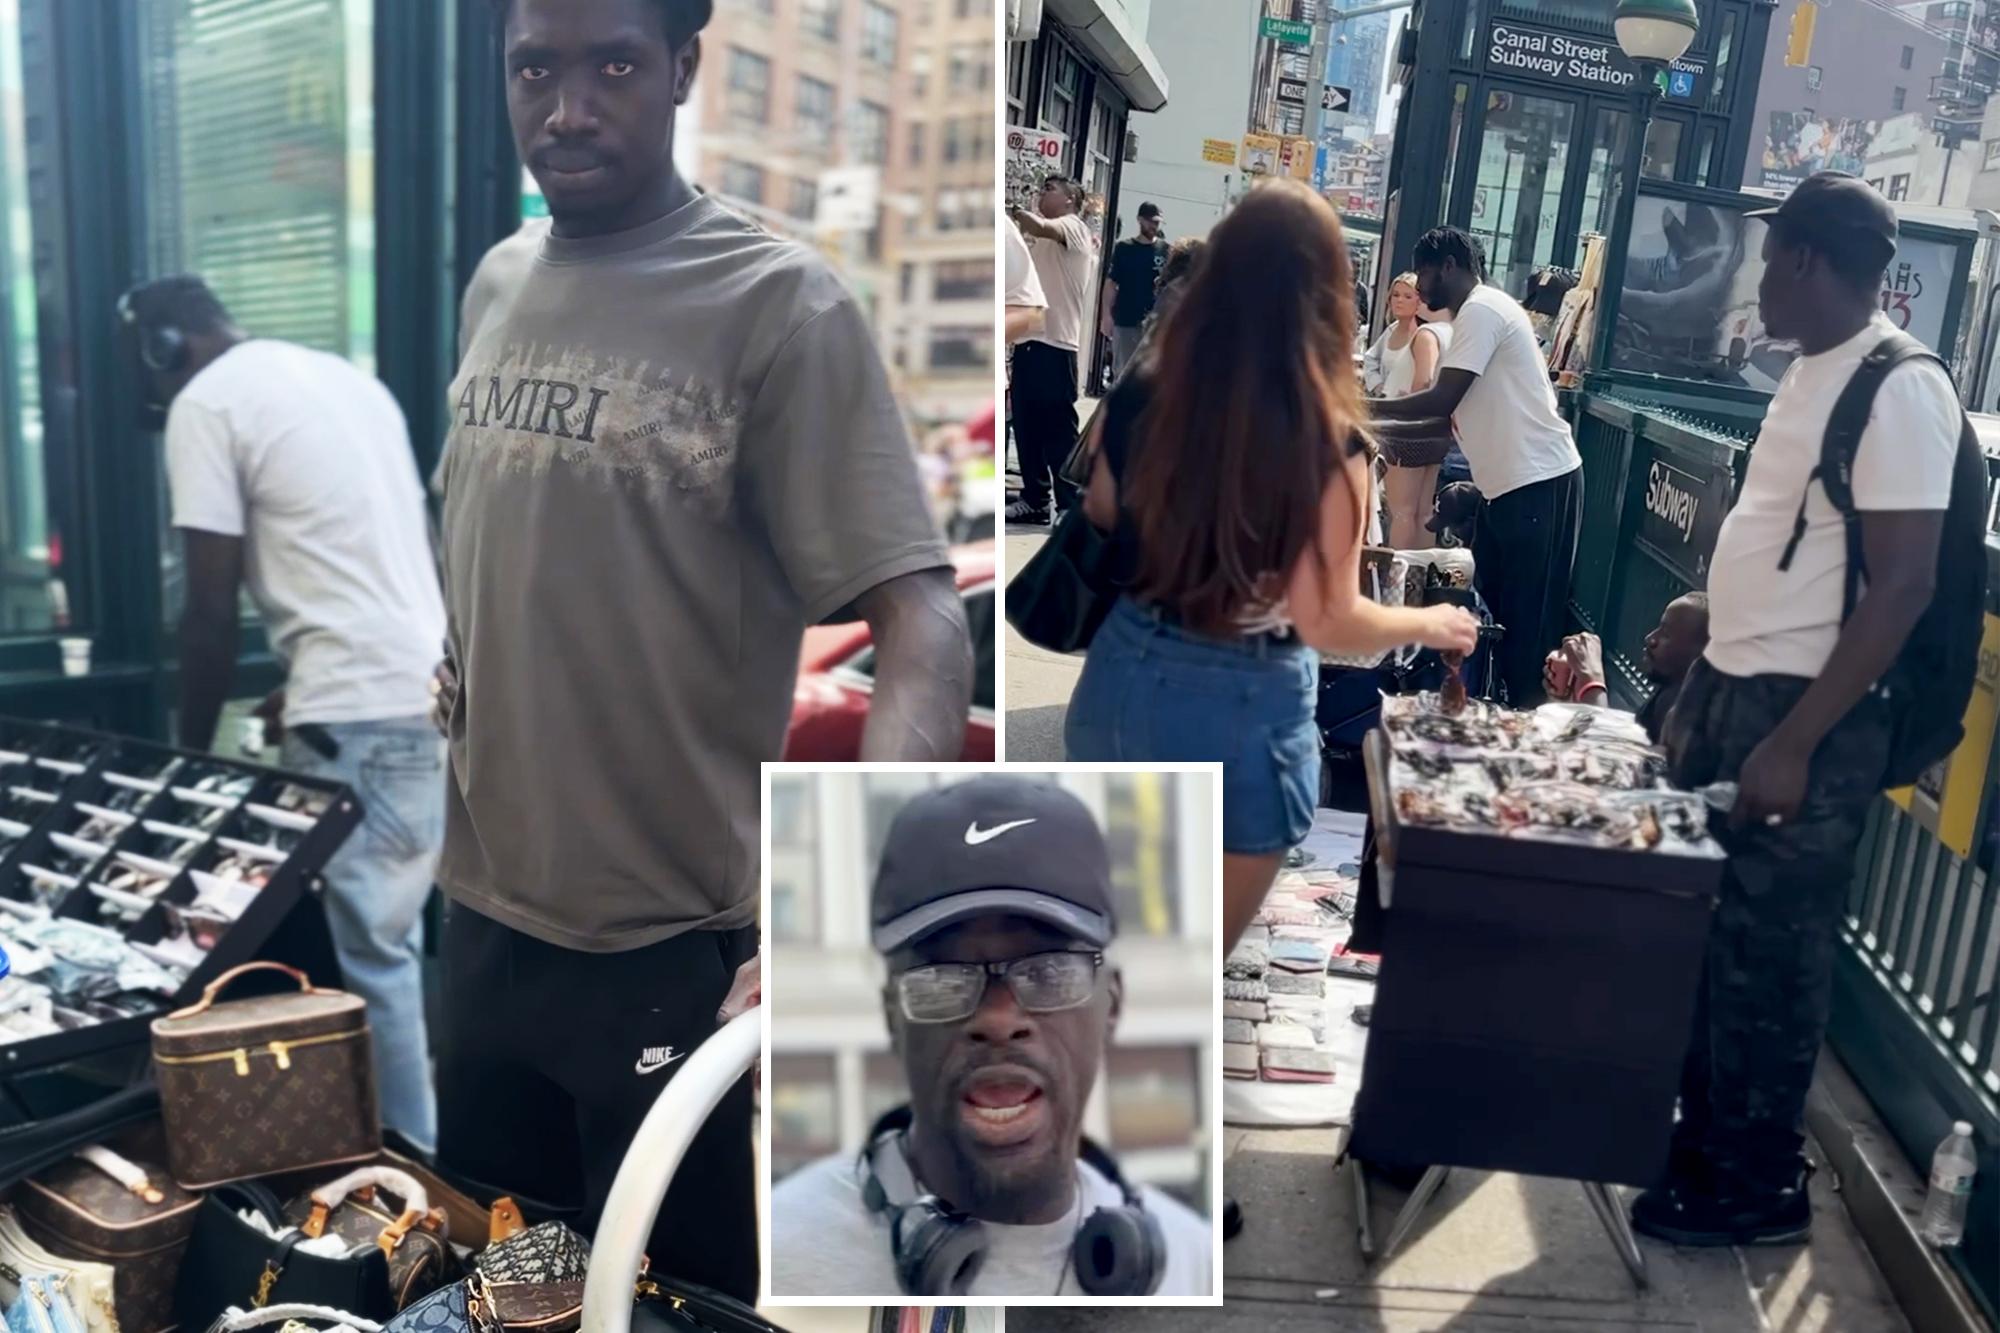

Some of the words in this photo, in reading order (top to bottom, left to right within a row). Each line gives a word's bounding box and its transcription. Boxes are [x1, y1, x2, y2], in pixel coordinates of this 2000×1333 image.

[1266, 20, 1309, 36] Lafayette
[1492, 27, 1547, 52] Canal
[1551, 37, 1609, 63] Street
[1490, 46, 1563, 77] Subway
[1567, 60, 1635, 85] Station
[1669, 59, 1704, 74] ntown
[1285, 86, 1304, 98] ONE
[1322, 93, 1337, 103] AY
[1037, 139, 1059, 157] 10
[1881, 290, 1911, 331] 13
[459, 375, 609, 443] AMIRI
[623, 421, 663, 441] AMIRI
[690, 446, 728, 466] AMIRI
[1646, 461, 1699, 543] Subway
[642, 1046, 674, 1064] NIKE
